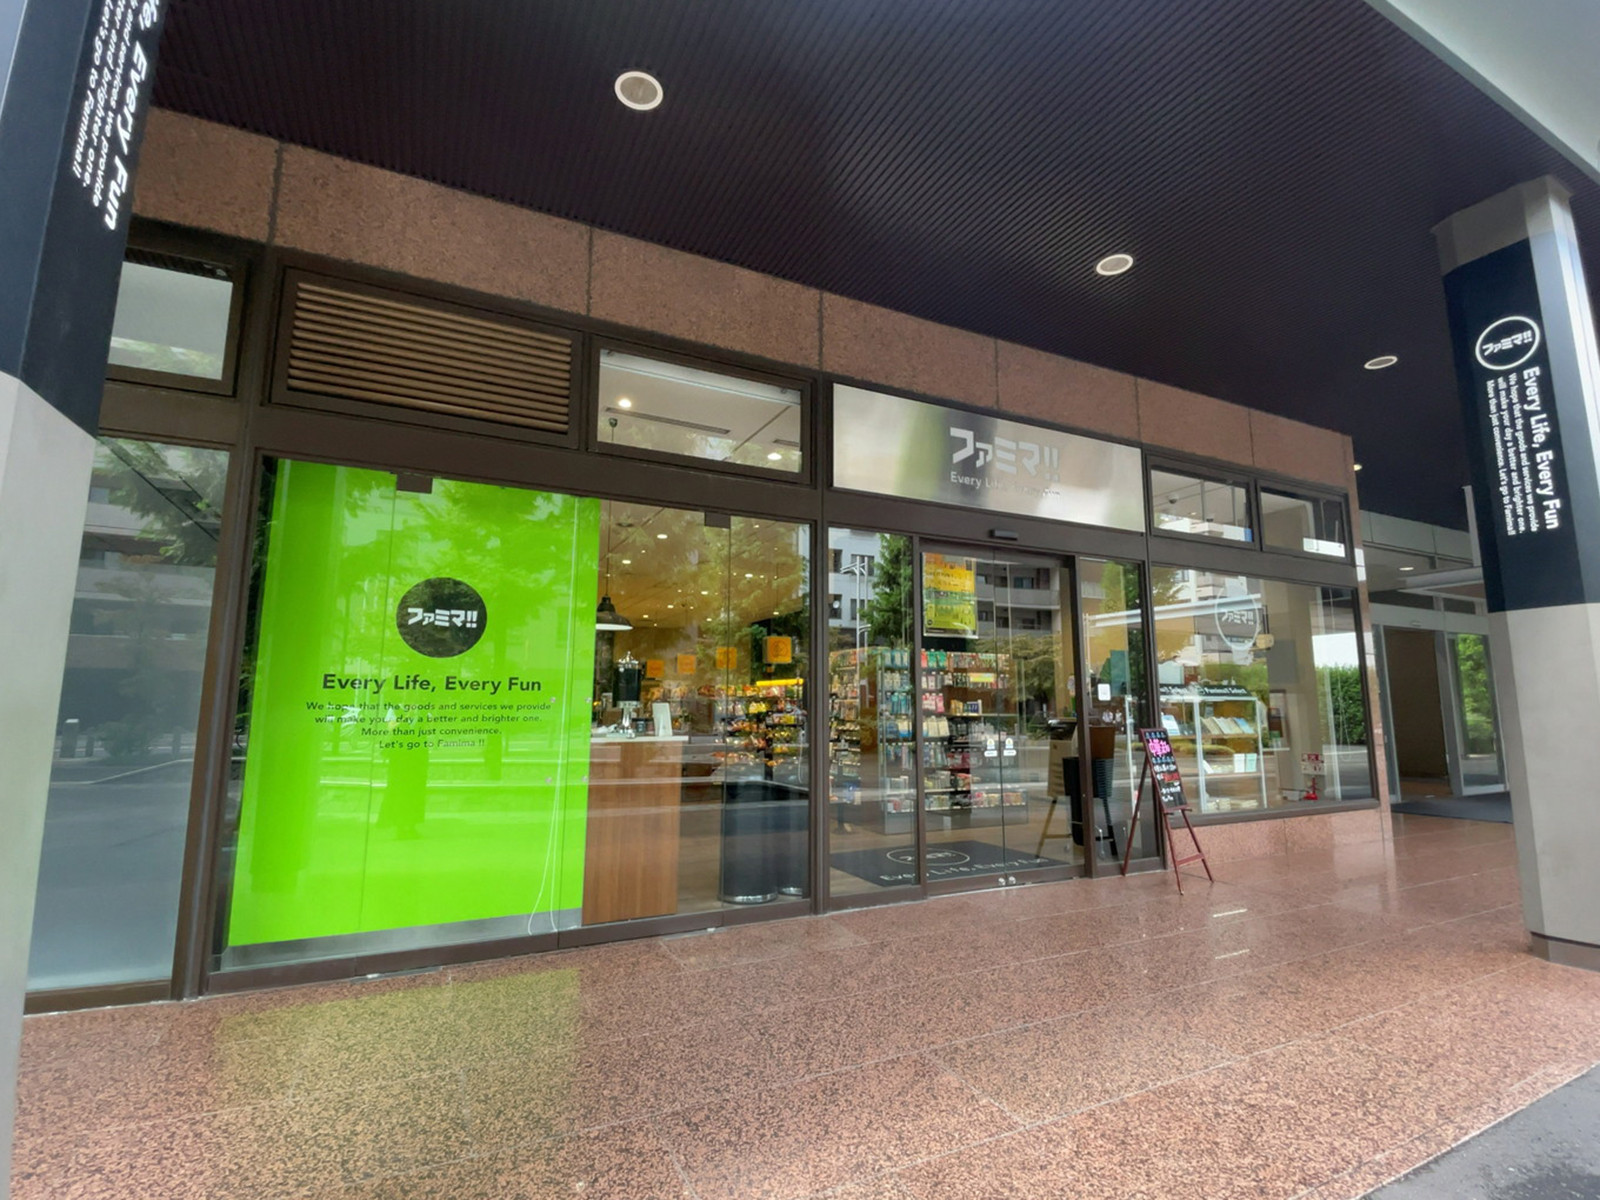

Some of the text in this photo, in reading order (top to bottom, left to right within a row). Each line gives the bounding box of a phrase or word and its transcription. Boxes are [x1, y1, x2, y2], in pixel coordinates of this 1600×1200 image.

[123, 8, 133, 46] and
[94, 35, 103, 66] go
[107, 29, 117, 70] and
[89, 68, 98, 89] to
[110, 41, 127, 109] services
[91, 66, 112, 146] brighter
[117, 41, 147, 155] Every
[105, 110, 115, 137] we
[93, 135, 108, 207] provide
[104, 155, 128, 230] Fun
[950, 427, 1059, 482] ファミマ!!
[1523, 366, 1561, 530] Every Life, Every Fun
[950, 471, 982, 490] Every
[407, 607, 478, 628] ファミマ!!
[322, 673, 542, 695] Every Life, Every Fun
[306, 702, 324, 710] We
[360, 702, 380, 710] that
[384, 702, 401, 710] the
[404, 703, 435, 712] goods
[516, 702, 551, 712] provide
[396, 714, 414, 724] day
[427, 714, 458, 722] better
[461, 714, 479, 722] and
[481, 715, 520, 724] brighter
[361, 728, 389, 736] More
[393, 727, 415, 736] than
[418, 727, 436, 737] just
[379, 741, 404, 749] Let's
[407, 741, 421, 750] go
